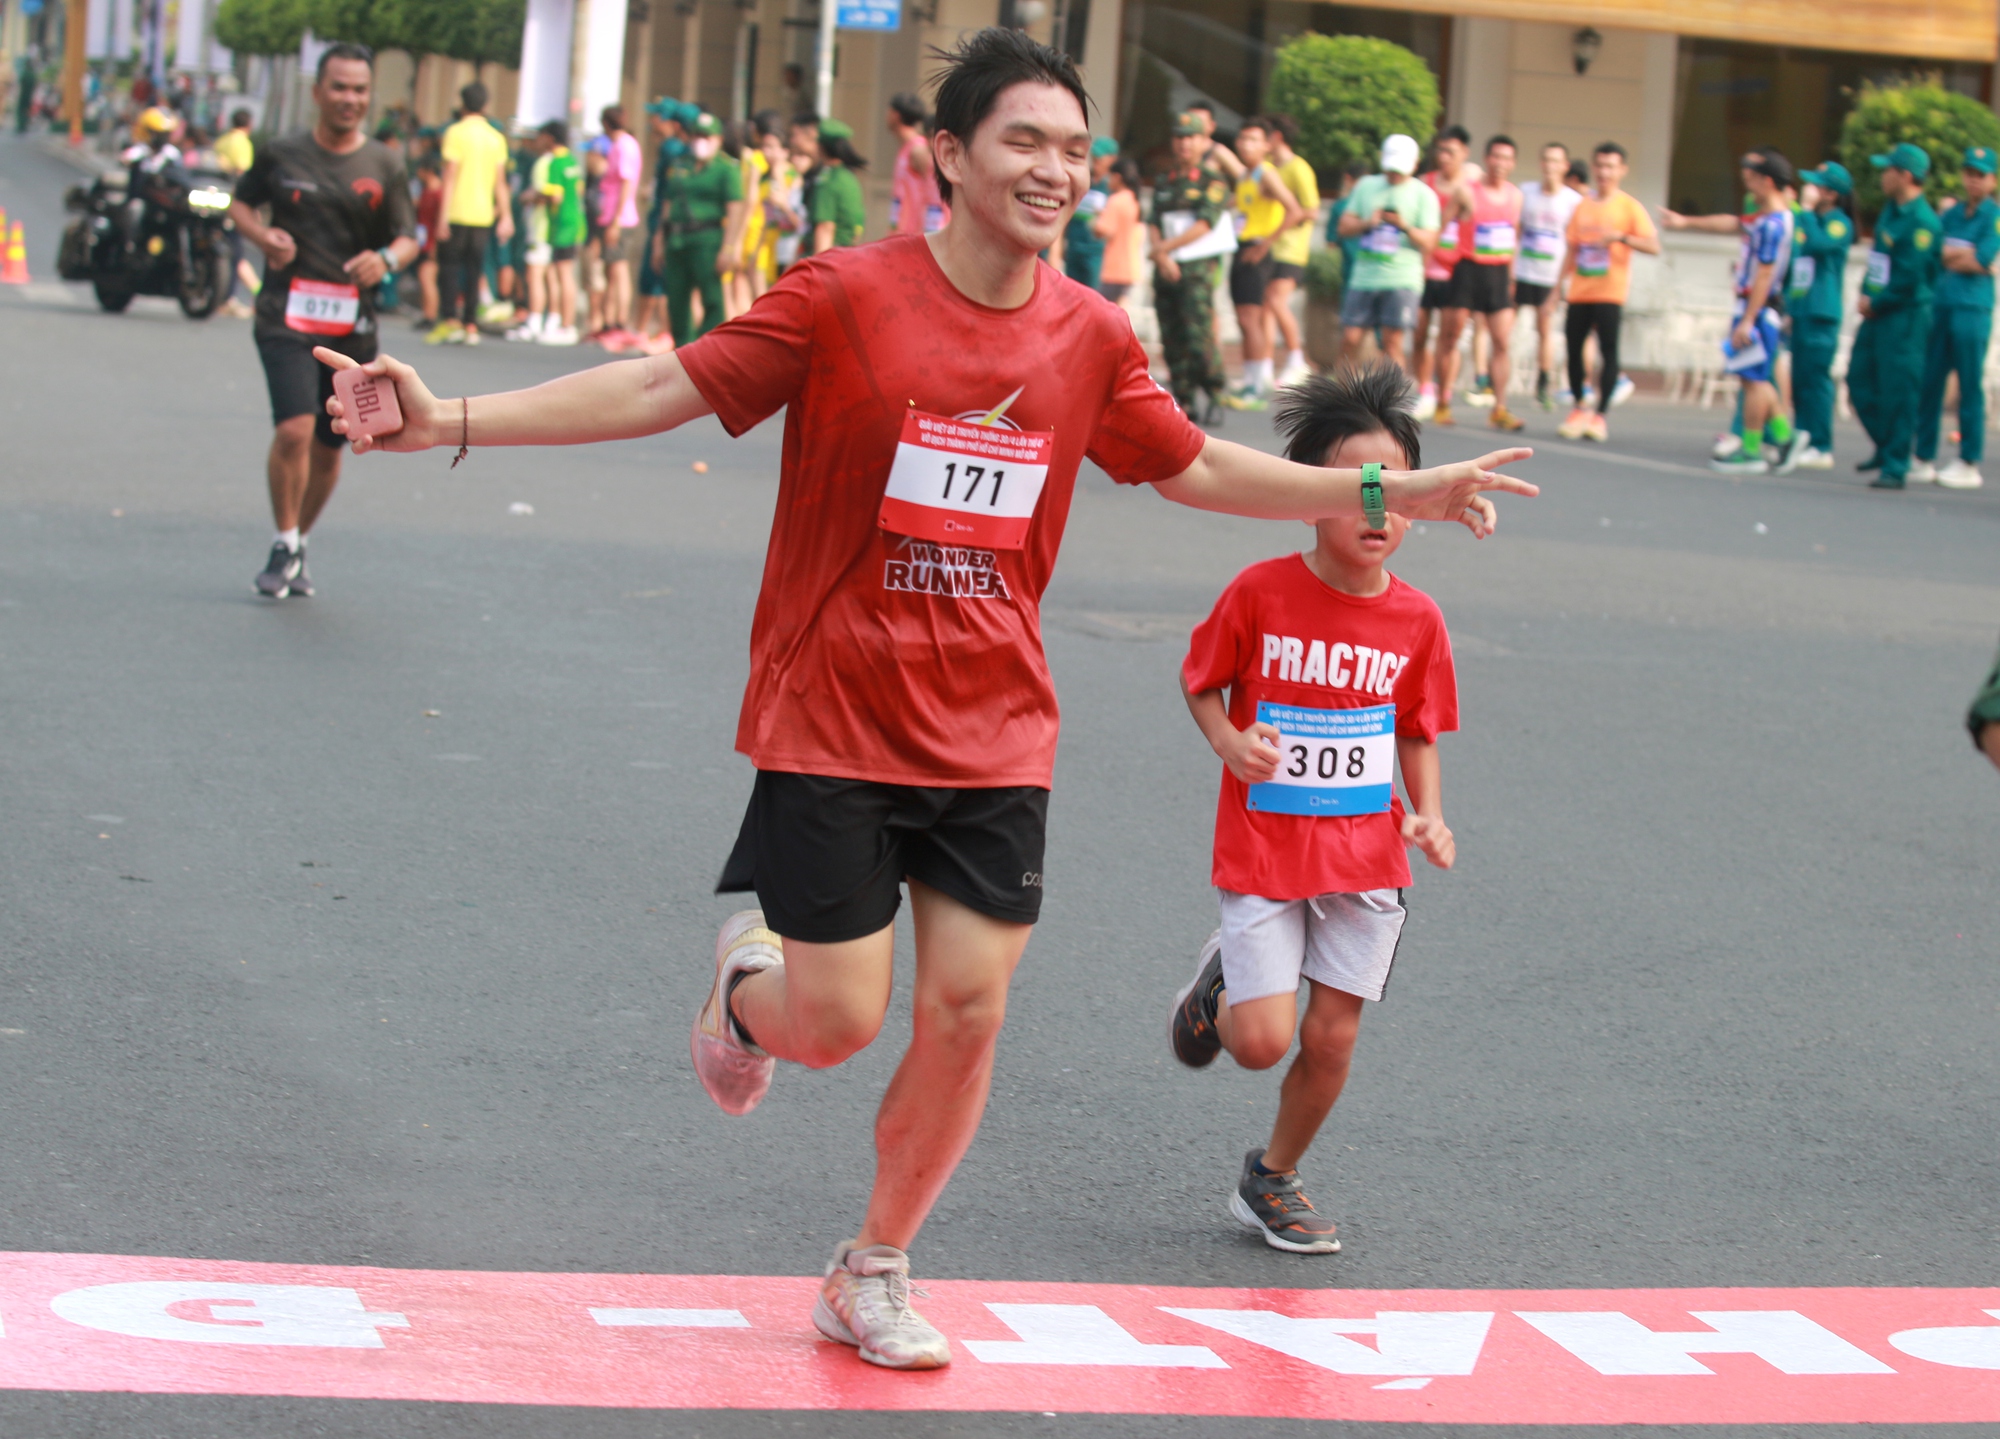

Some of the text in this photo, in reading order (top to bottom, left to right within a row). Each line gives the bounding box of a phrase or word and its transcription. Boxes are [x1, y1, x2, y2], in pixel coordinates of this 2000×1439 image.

[305, 298, 342, 317] 079
[352, 383, 381, 423] JBL
[942, 462, 1005, 507] 171
[910, 543, 996, 569] WONDER
[884, 560, 1011, 600] RUNNER
[1287, 745, 1365, 779] 308
[0, 1281, 410, 1348] Đ
